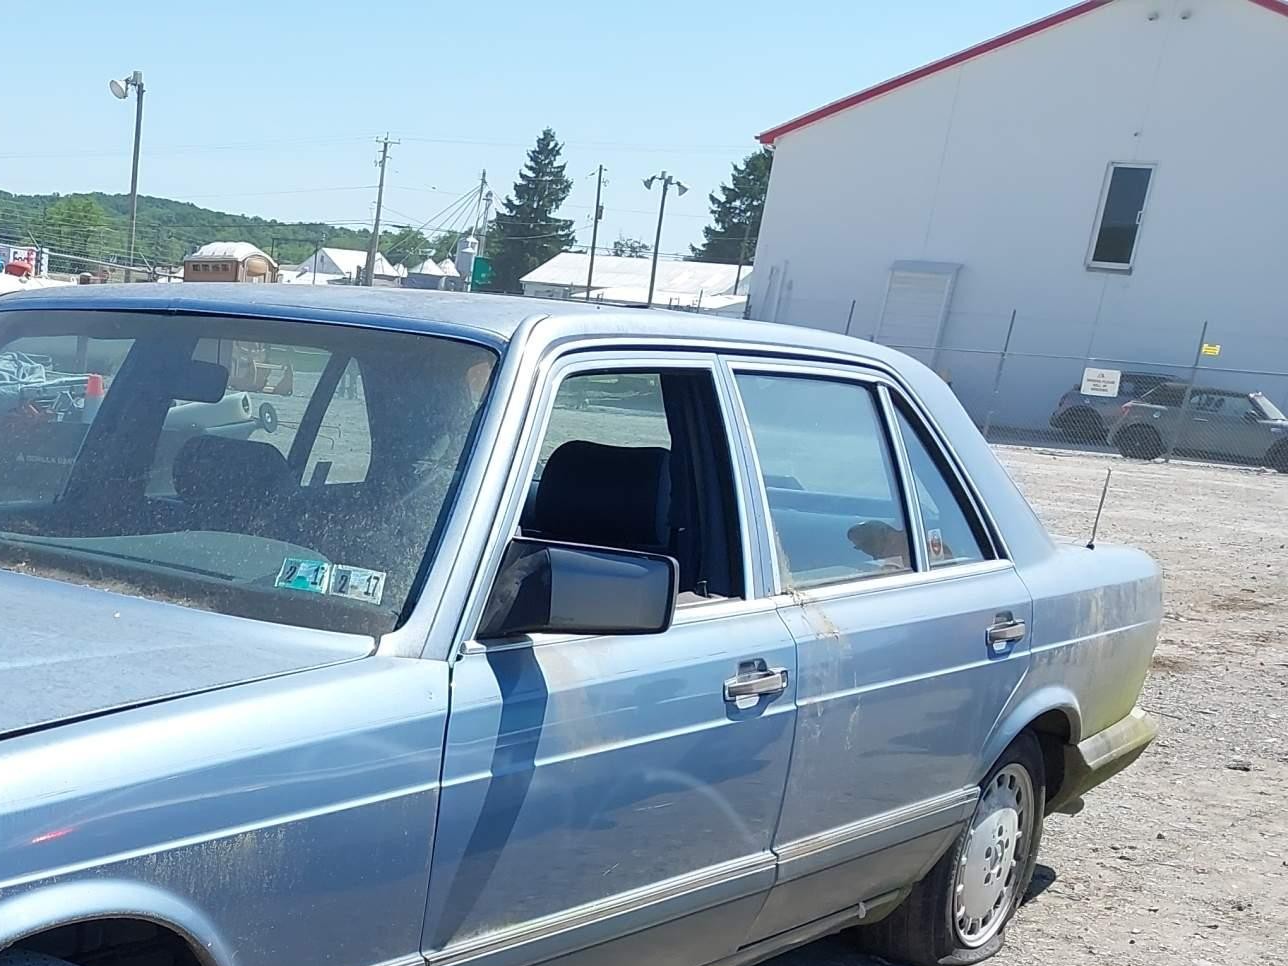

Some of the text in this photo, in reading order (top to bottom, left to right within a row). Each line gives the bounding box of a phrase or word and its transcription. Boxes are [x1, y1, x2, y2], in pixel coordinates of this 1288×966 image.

[286, 565, 298, 583] 2
[338, 574, 381, 597] 2 17
